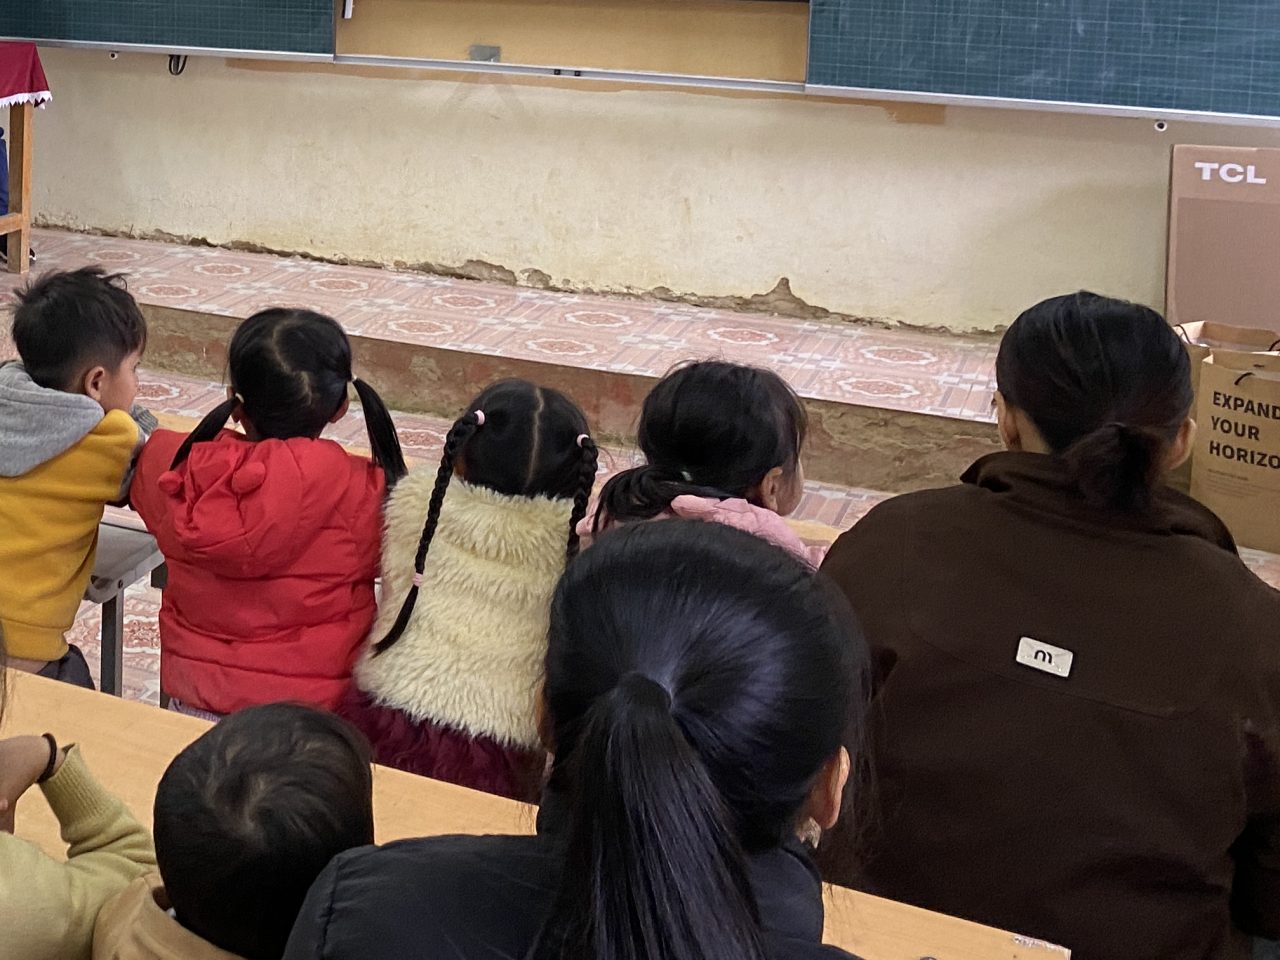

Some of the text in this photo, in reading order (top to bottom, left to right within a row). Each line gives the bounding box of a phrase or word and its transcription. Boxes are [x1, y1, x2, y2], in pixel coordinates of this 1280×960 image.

[1194, 161, 1266, 184] TCL
[1213, 391, 1280, 420] EXPAND
[1211, 415, 1260, 441] YOUR
